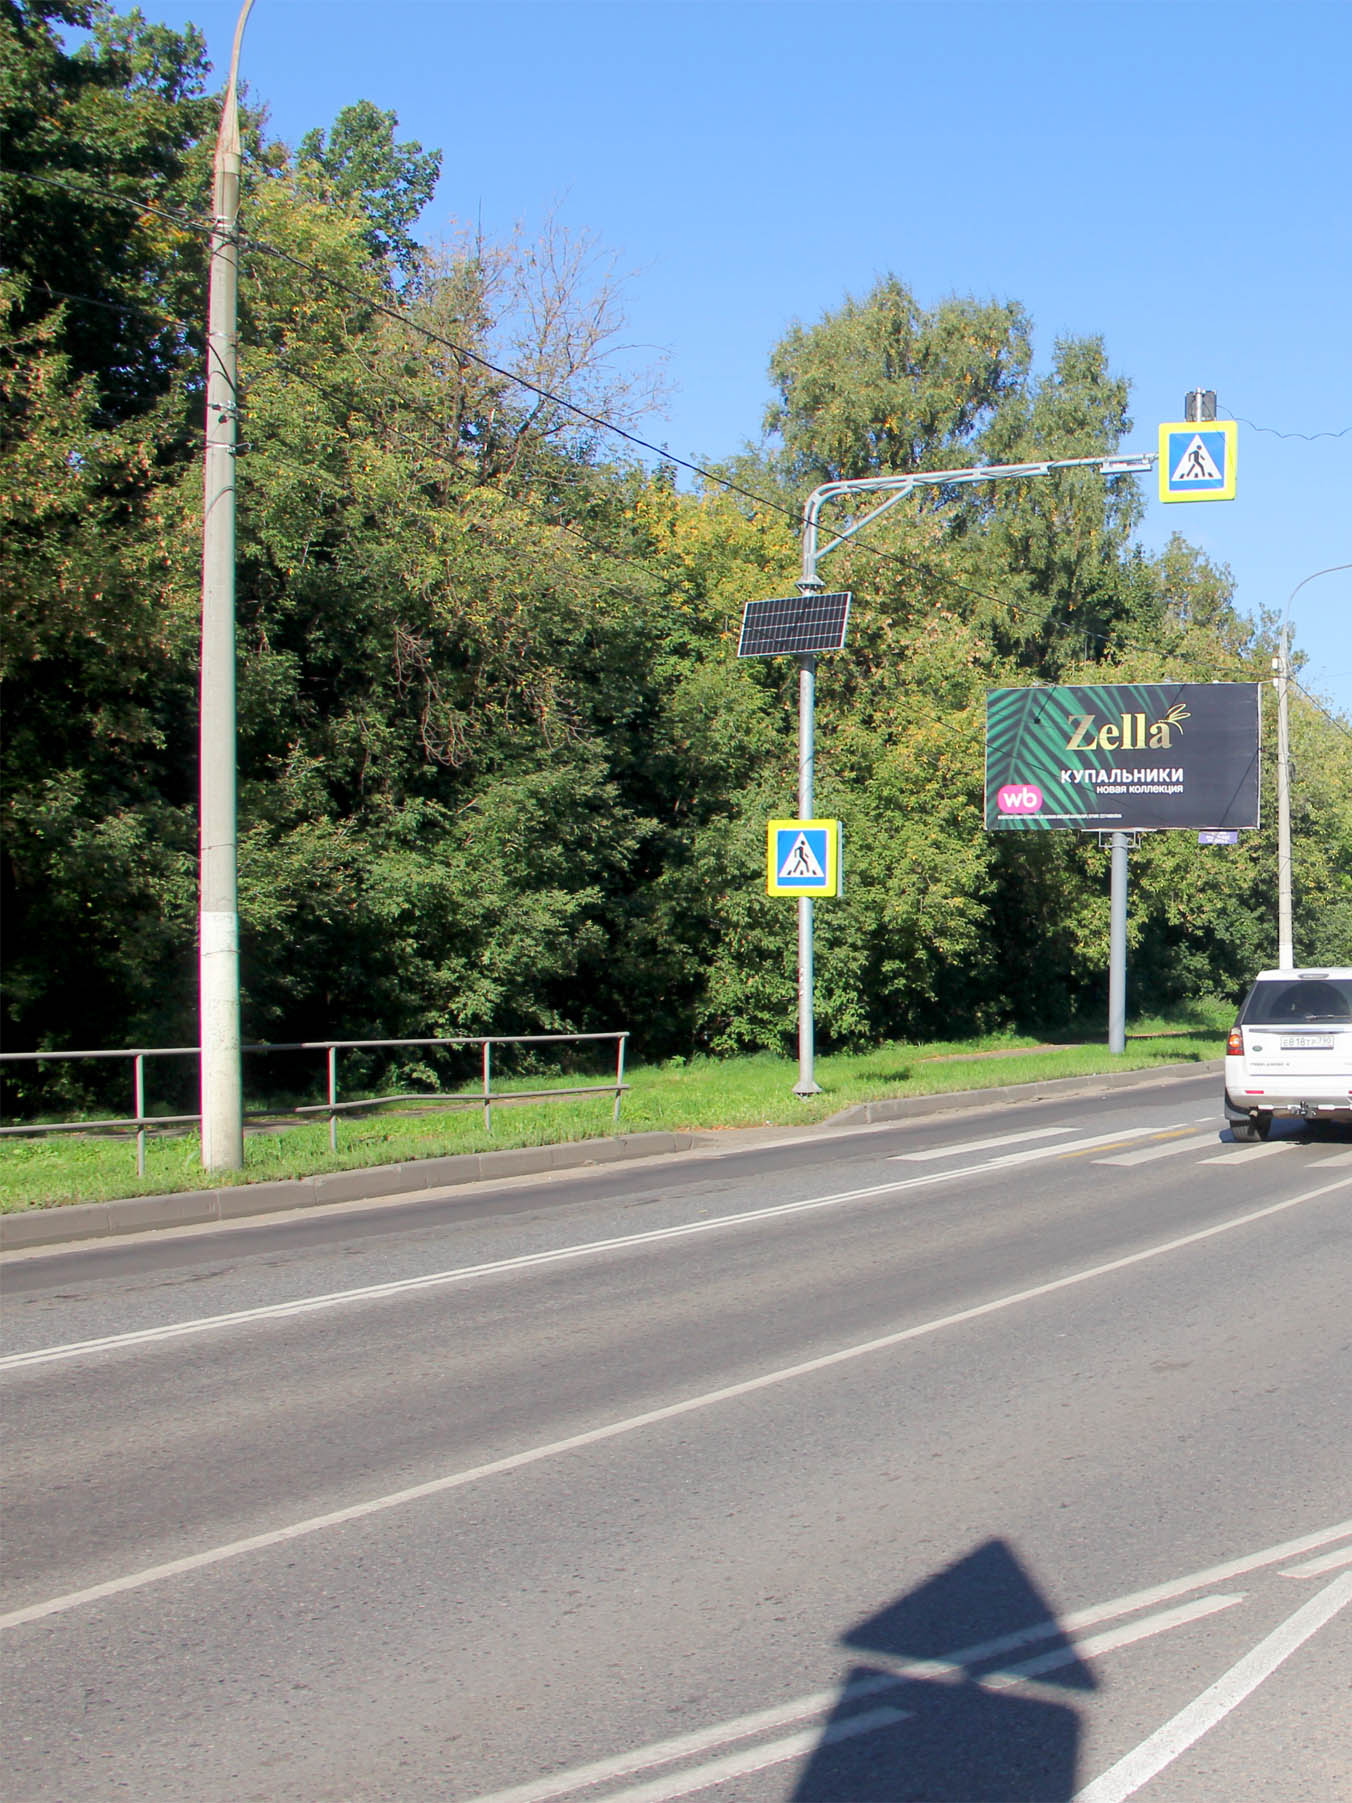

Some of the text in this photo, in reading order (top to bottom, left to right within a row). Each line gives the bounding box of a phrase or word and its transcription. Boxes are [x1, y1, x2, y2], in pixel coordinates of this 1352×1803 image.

[1065, 713, 1173, 750] Zella
[1060, 768, 1184, 783] КУПАЛЬНИКИ
[1003, 787, 1038, 808] wb
[1096, 784, 1184, 796] новая коллекция
